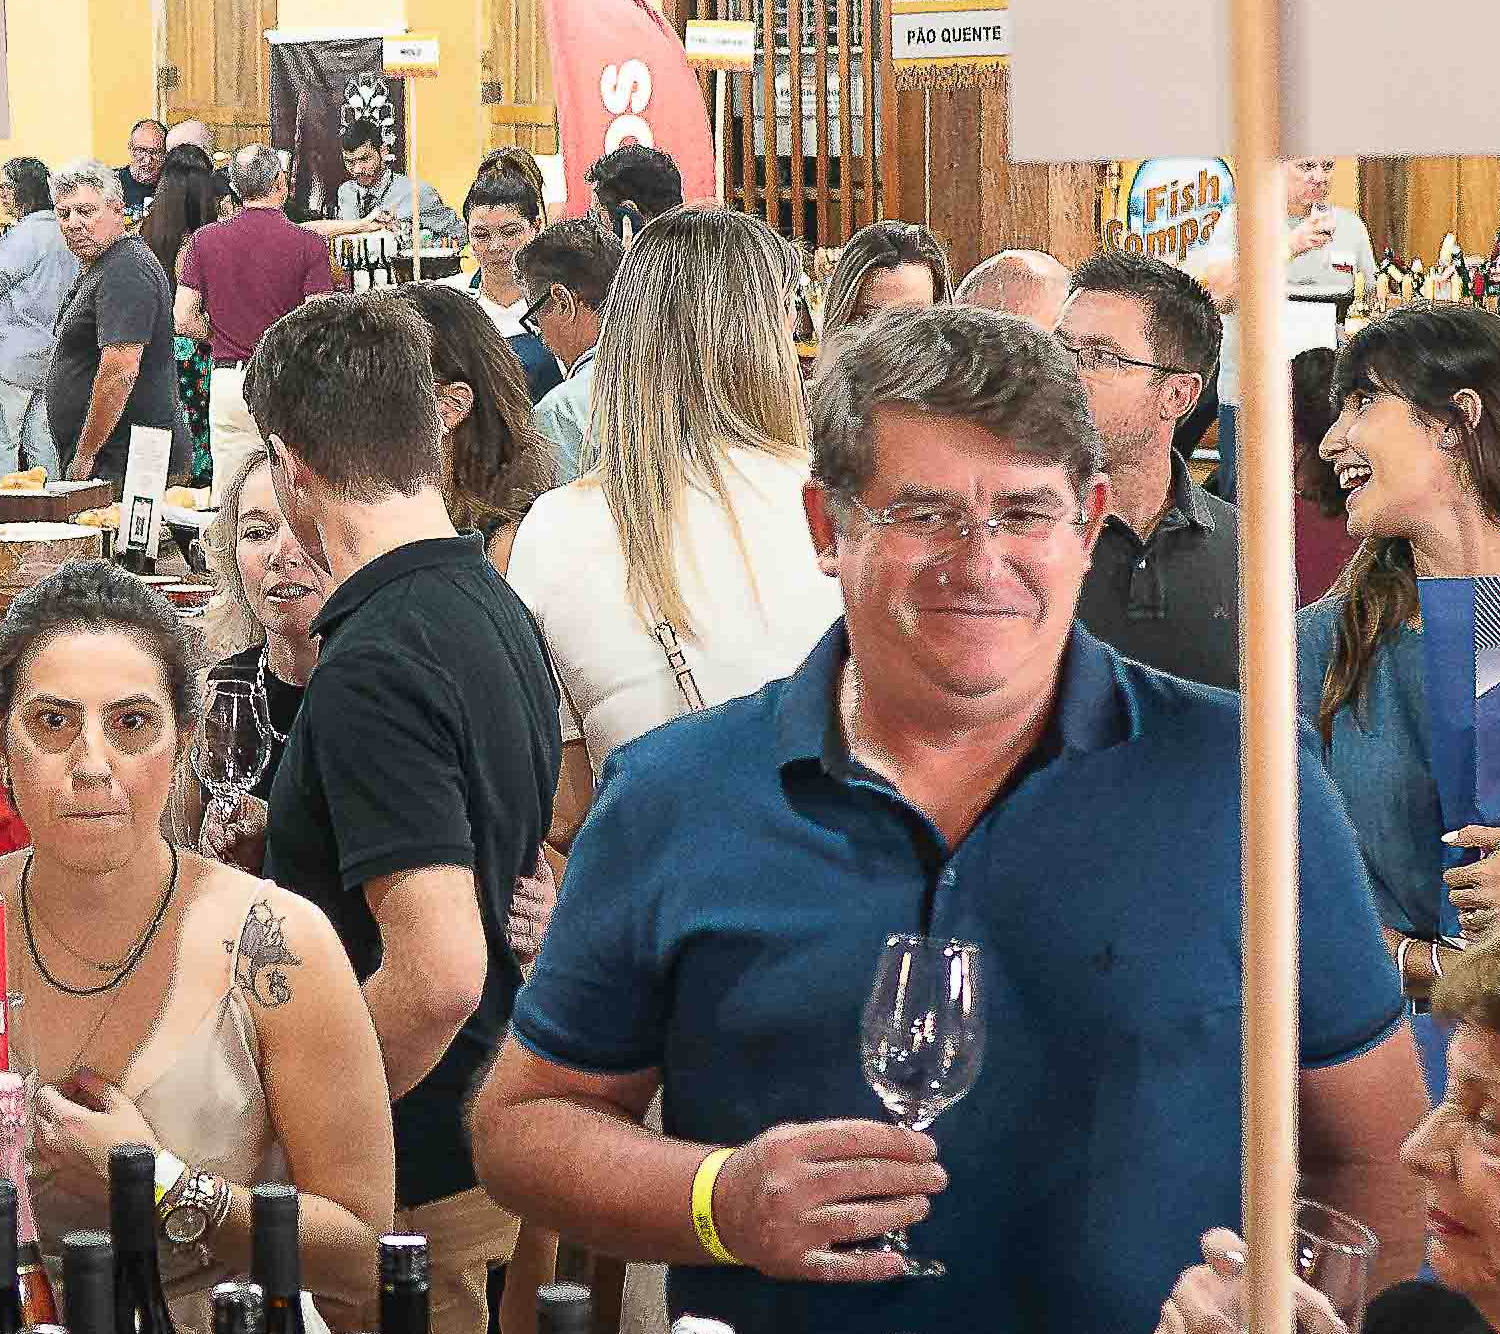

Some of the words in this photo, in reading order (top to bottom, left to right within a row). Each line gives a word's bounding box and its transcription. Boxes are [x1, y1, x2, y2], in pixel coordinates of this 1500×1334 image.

[907, 26, 937, 45] PÃO
[941, 25, 1001, 44] QUENTE
[1145, 169, 1221, 223] Fish
